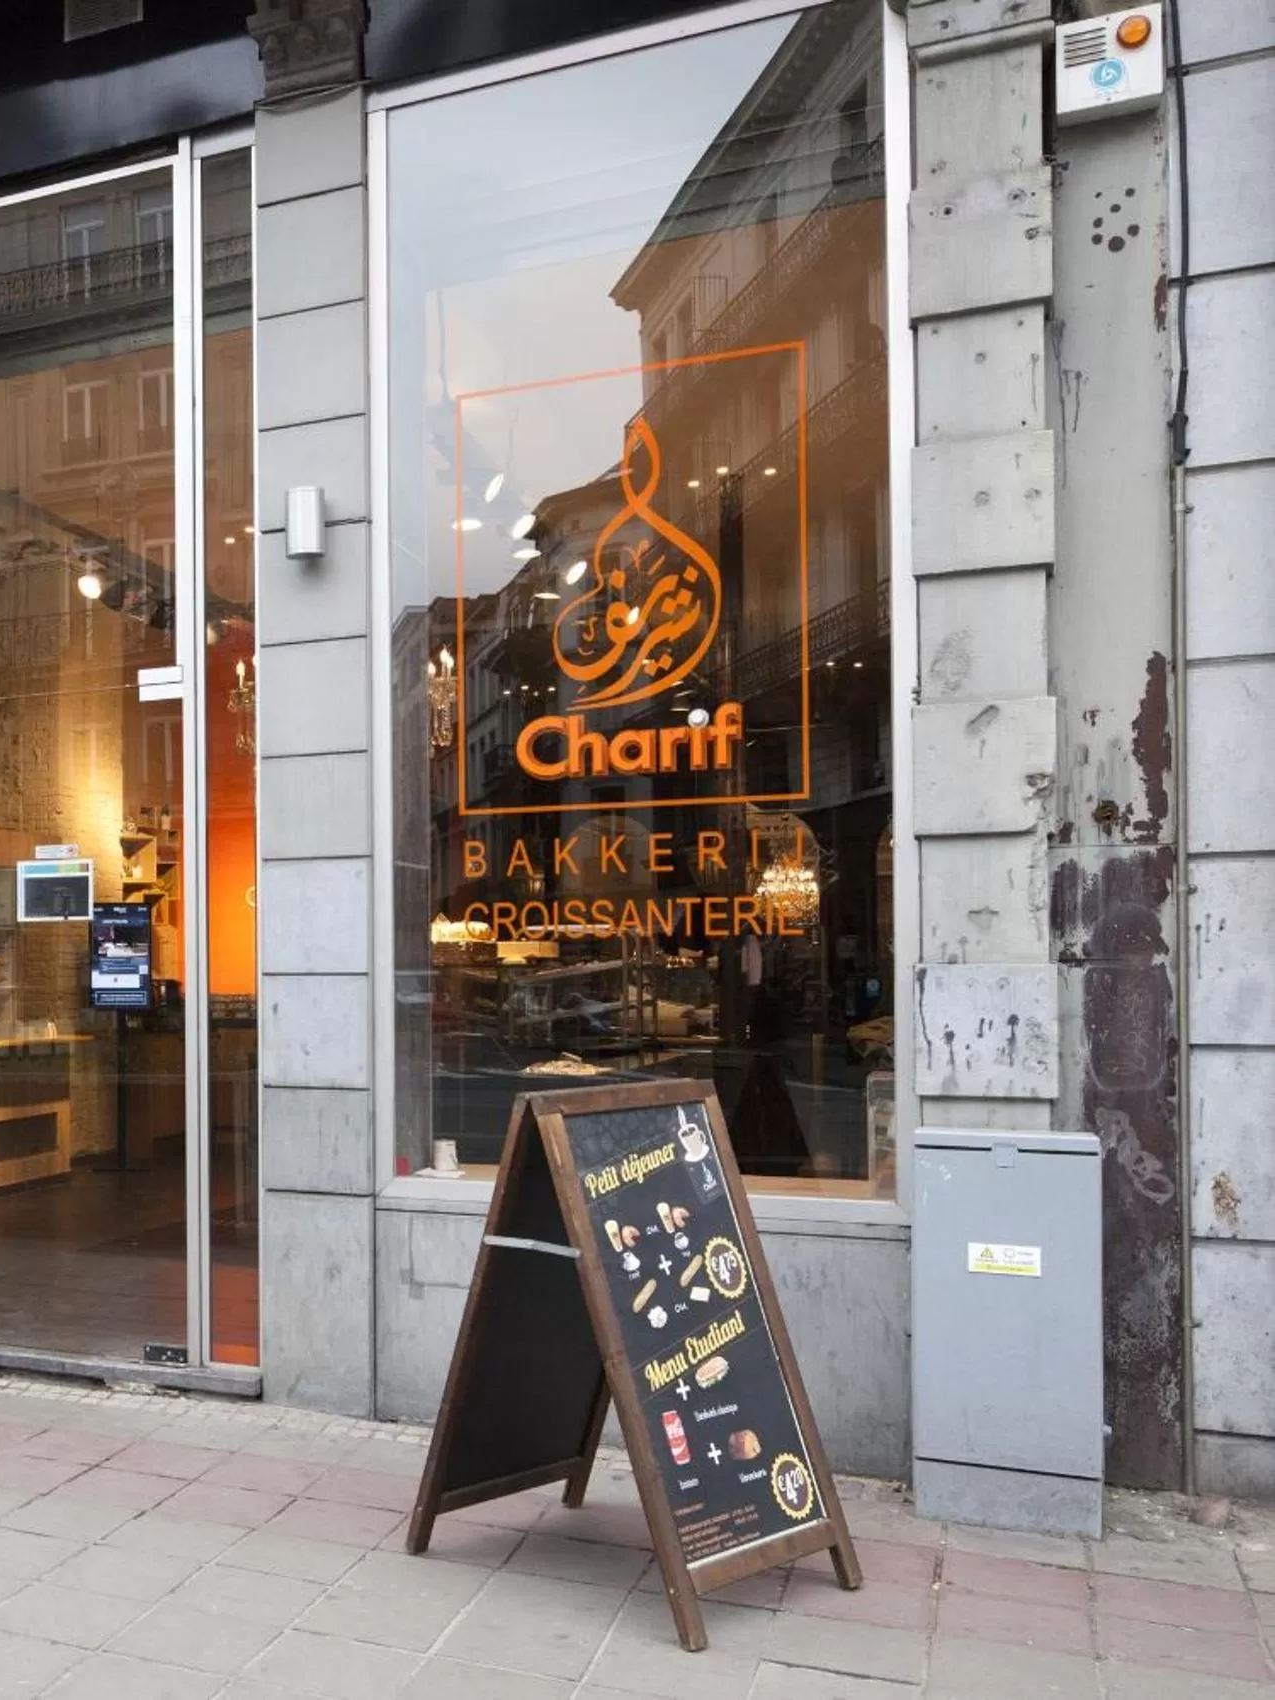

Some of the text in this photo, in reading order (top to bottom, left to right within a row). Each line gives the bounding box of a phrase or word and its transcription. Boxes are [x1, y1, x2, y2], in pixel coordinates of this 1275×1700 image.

[516, 702, 744, 781] Charif
[464, 897, 805, 943] CROISSANTERIE
[585, 1142, 676, 1200] Petit déjeuner
[644, 1352, 688, 1393] Menu
